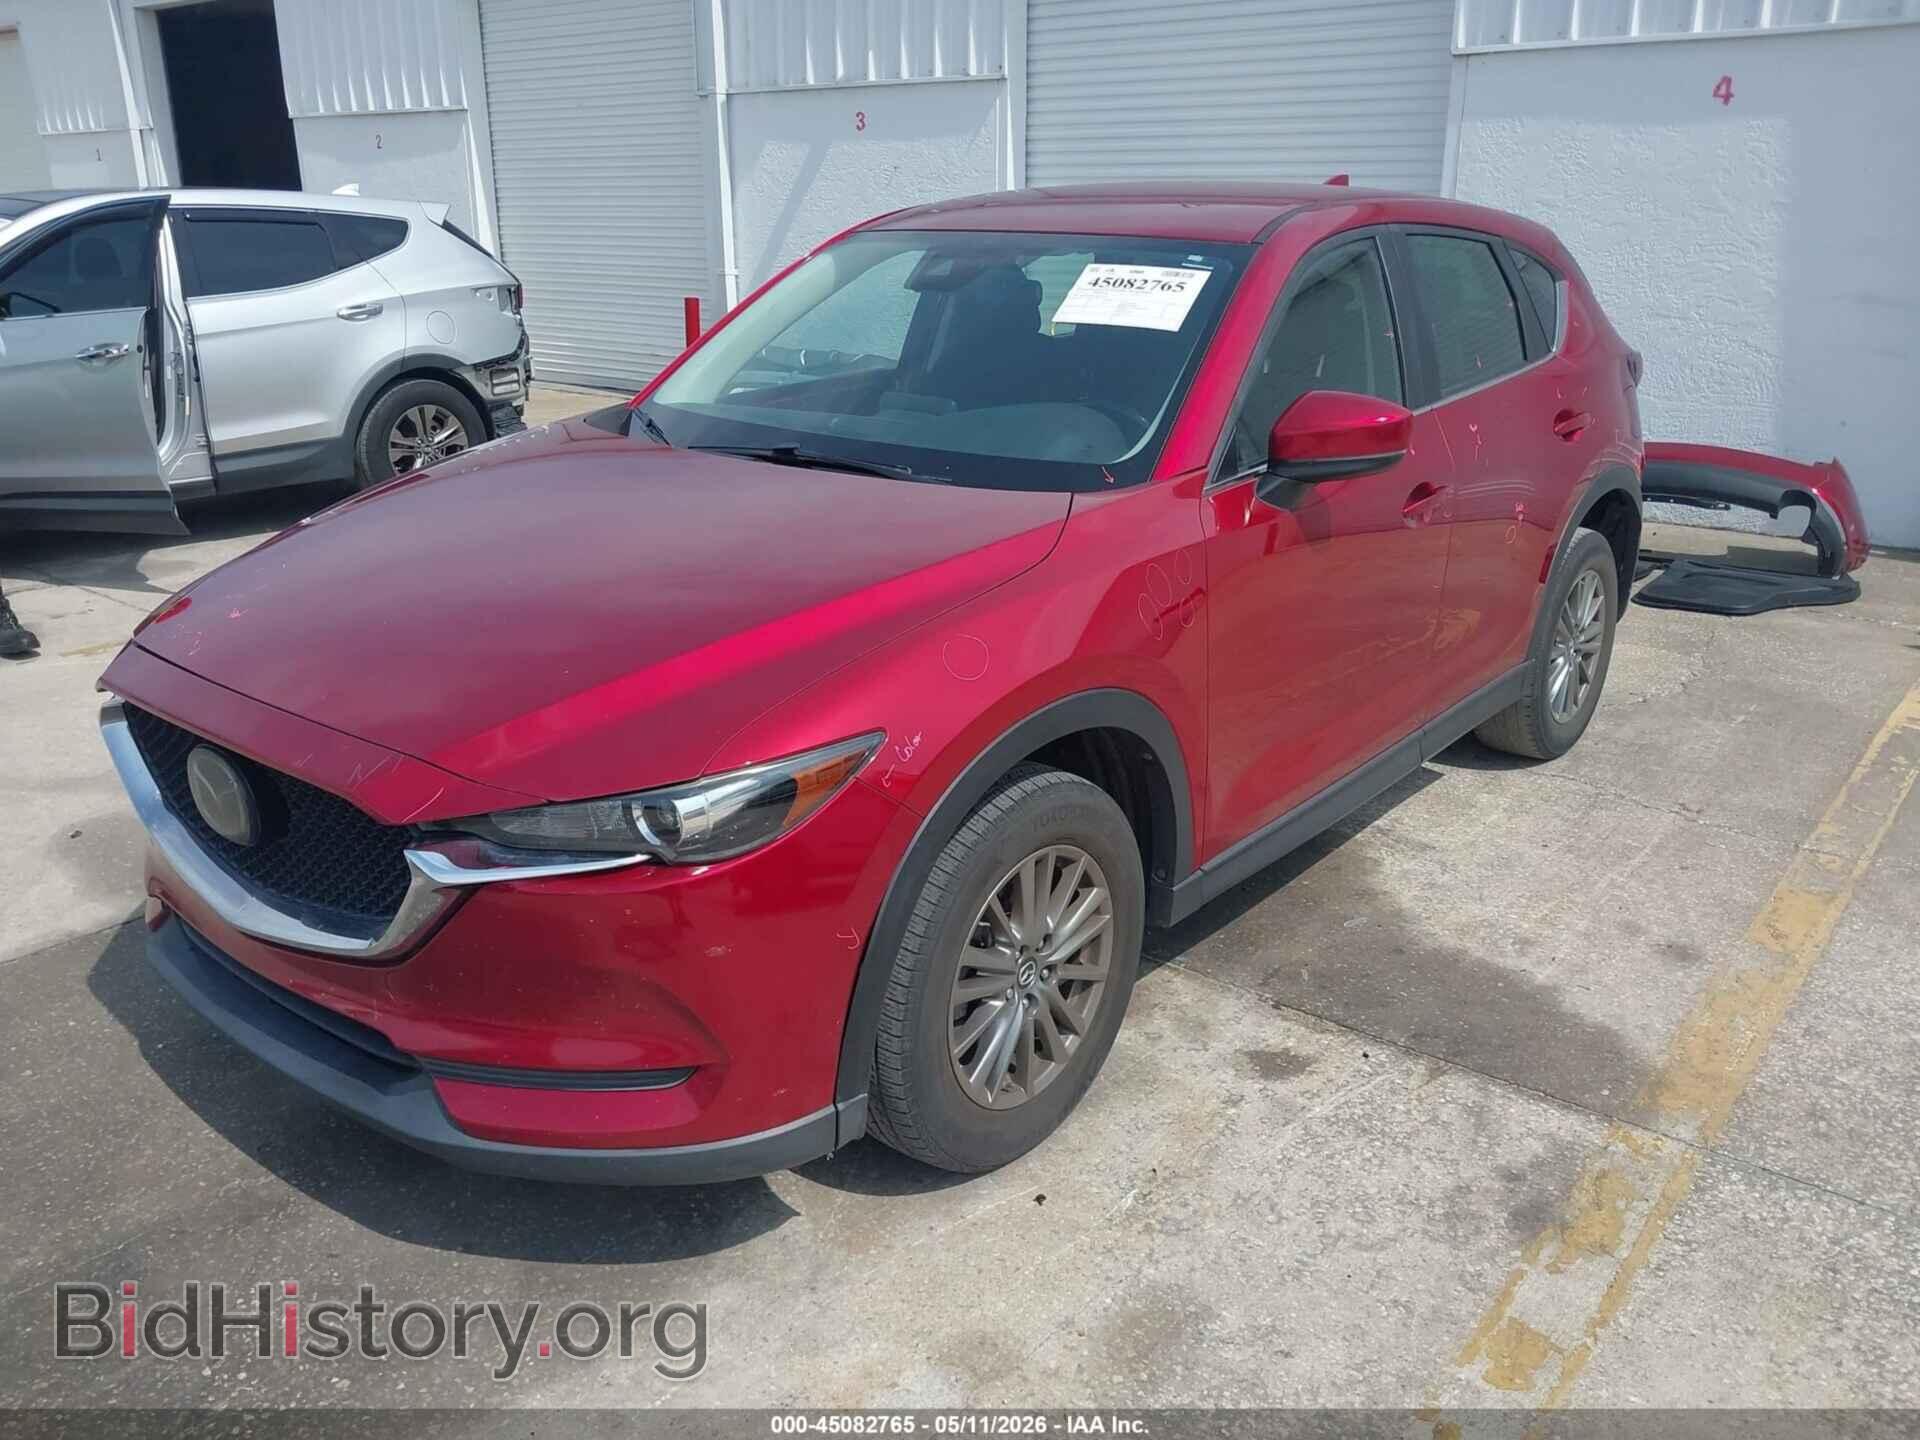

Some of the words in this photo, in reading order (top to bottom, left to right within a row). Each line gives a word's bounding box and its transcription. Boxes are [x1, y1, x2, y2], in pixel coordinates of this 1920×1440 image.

[1712, 75, 1735, 106] 4
[855, 111, 866, 132] 3
[375, 134, 384, 150] 2
[95, 148, 103, 162] 1
[1087, 277, 1187, 293] 45082765
